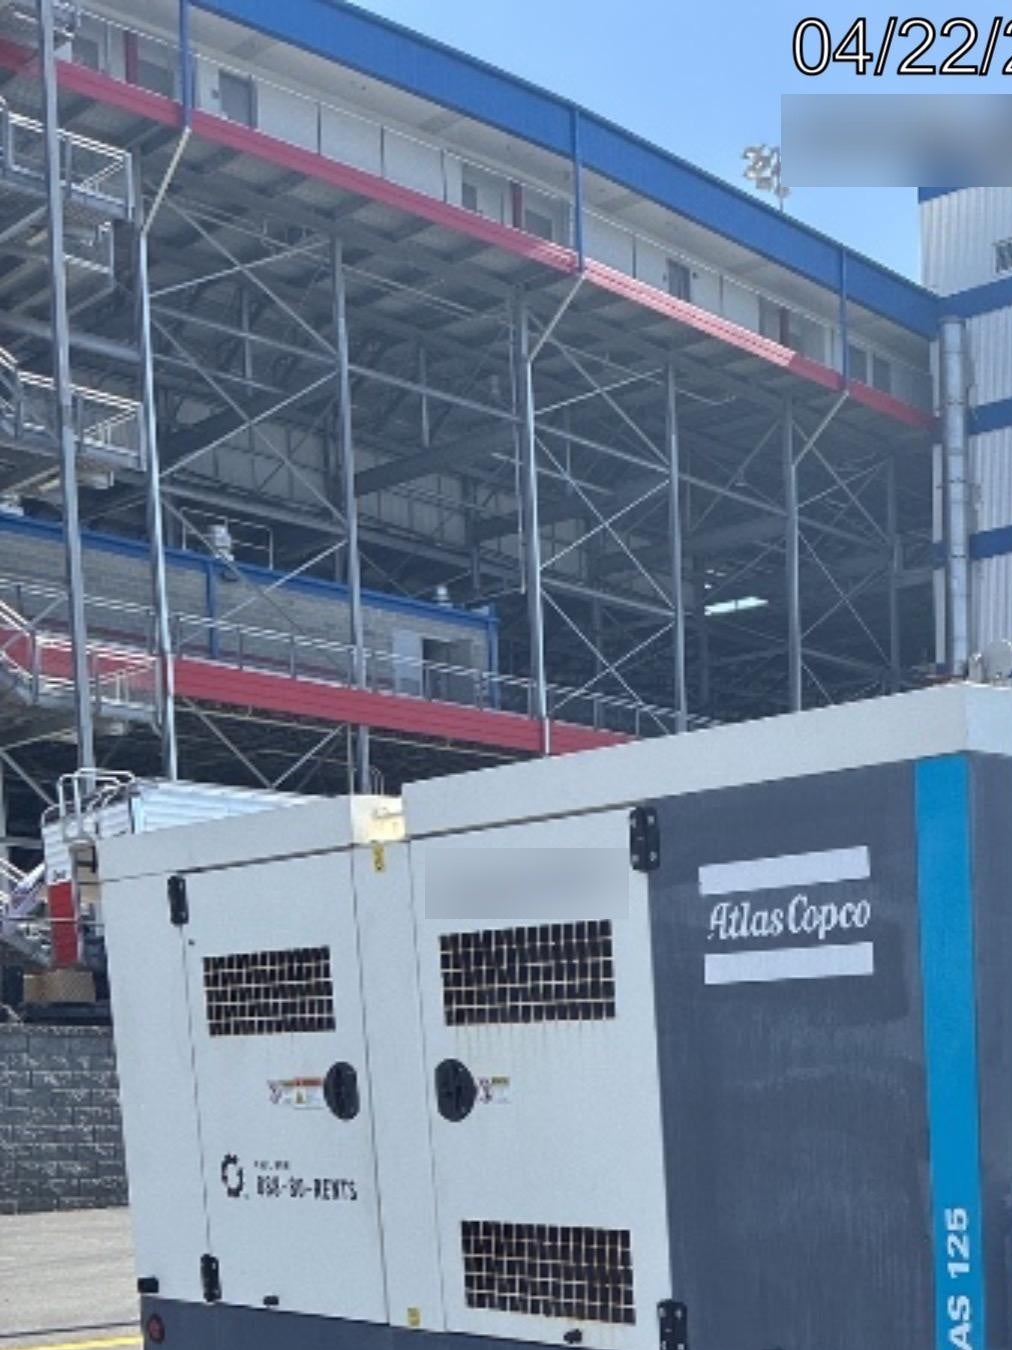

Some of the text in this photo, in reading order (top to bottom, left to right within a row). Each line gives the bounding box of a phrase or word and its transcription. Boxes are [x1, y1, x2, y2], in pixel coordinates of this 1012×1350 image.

[707, 893, 871, 940] Atlas Copco
[944, 1208, 971, 1279] 125
